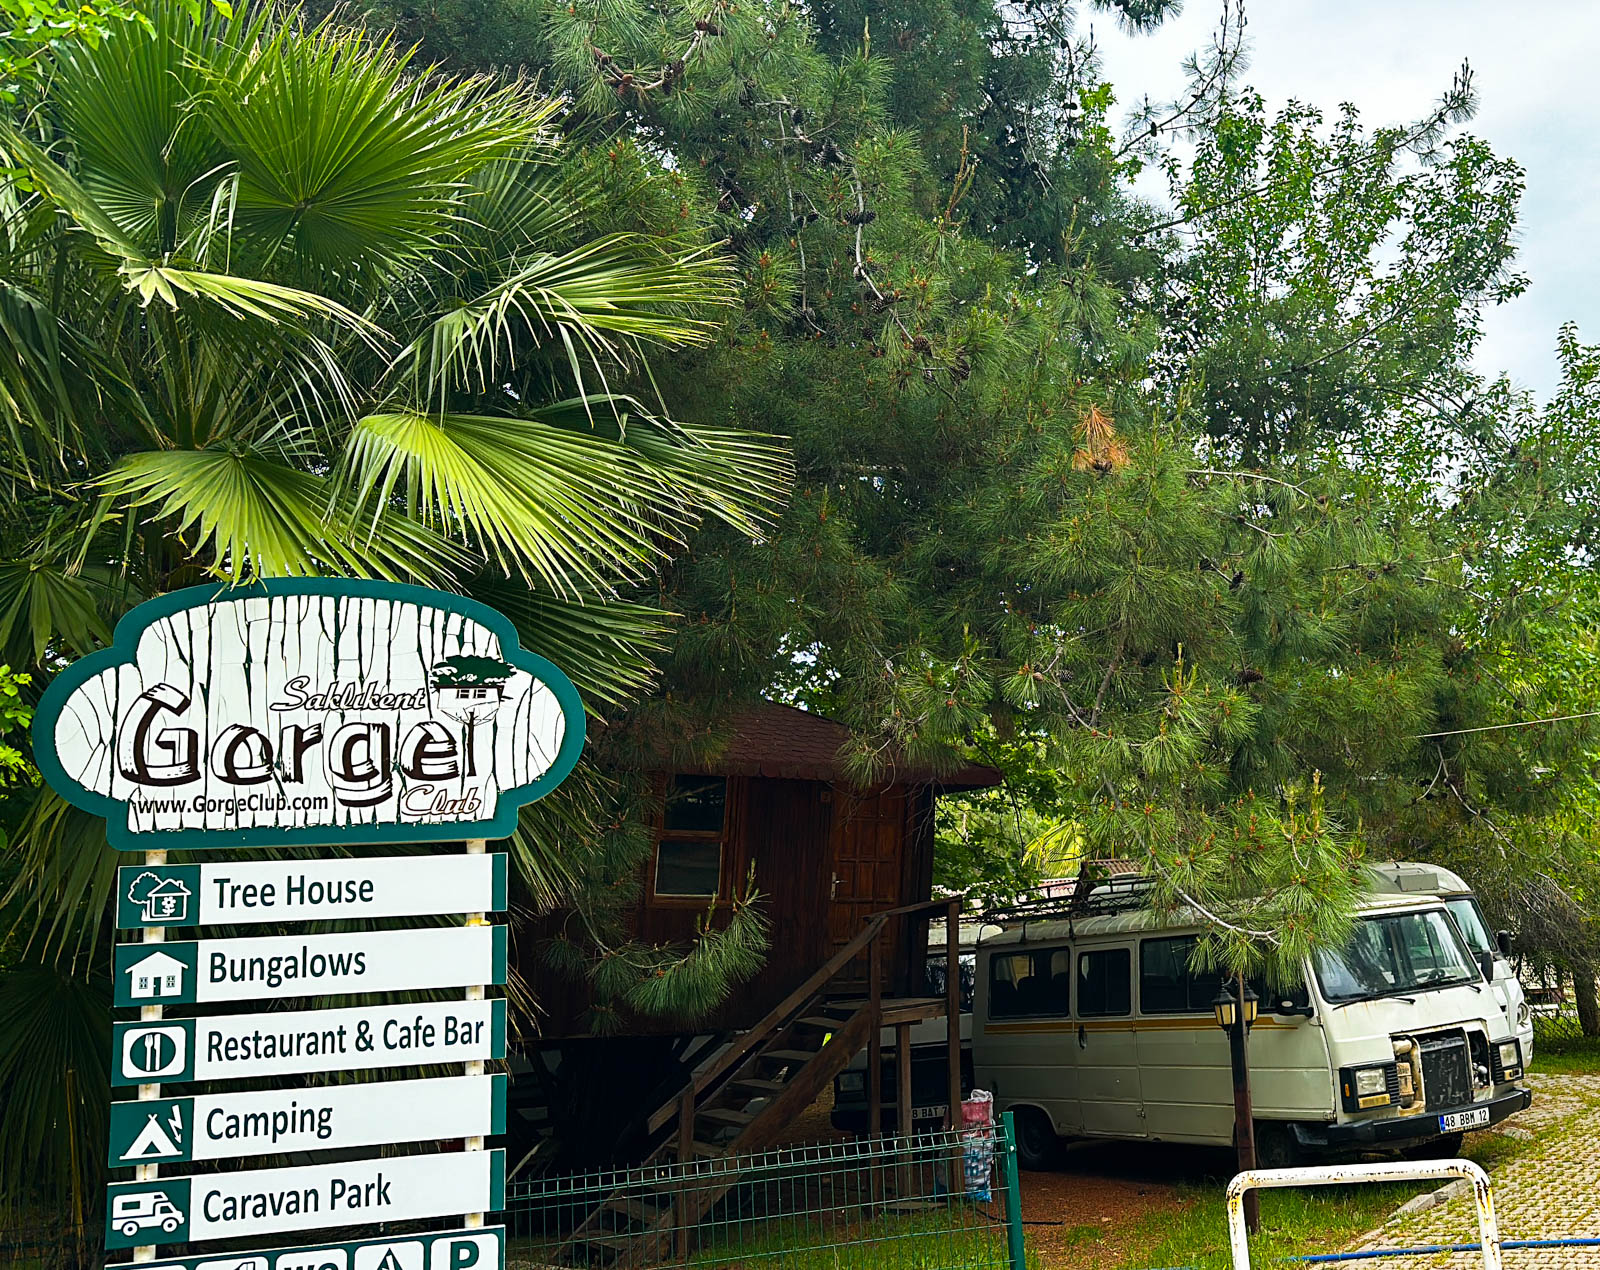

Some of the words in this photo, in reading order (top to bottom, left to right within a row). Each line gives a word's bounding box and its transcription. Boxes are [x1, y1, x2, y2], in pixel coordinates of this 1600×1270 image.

[117, 683, 459, 807] Gorge
[138, 794, 328, 816] www.GorgeClub.com
[401, 784, 481, 816] Club
[213, 877, 275, 908] Tree
[286, 874, 374, 905] House
[209, 946, 366, 987] Bungalows
[207, 1025, 347, 1062] Restaurant
[355, 1020, 374, 1052] &
[383, 1016, 435, 1049] Cafe
[444, 1016, 484, 1045] Bar
[206, 1101, 333, 1143] Camping
[1445, 1116, 1456, 1128] 48
[1460, 1112, 1476, 1126] BBM
[1479, 1110, 1487, 1122] 12
[203, 1188, 319, 1222] Caravan
[330, 1173, 392, 1210] Park
[450, 1240, 479, 1270] P
